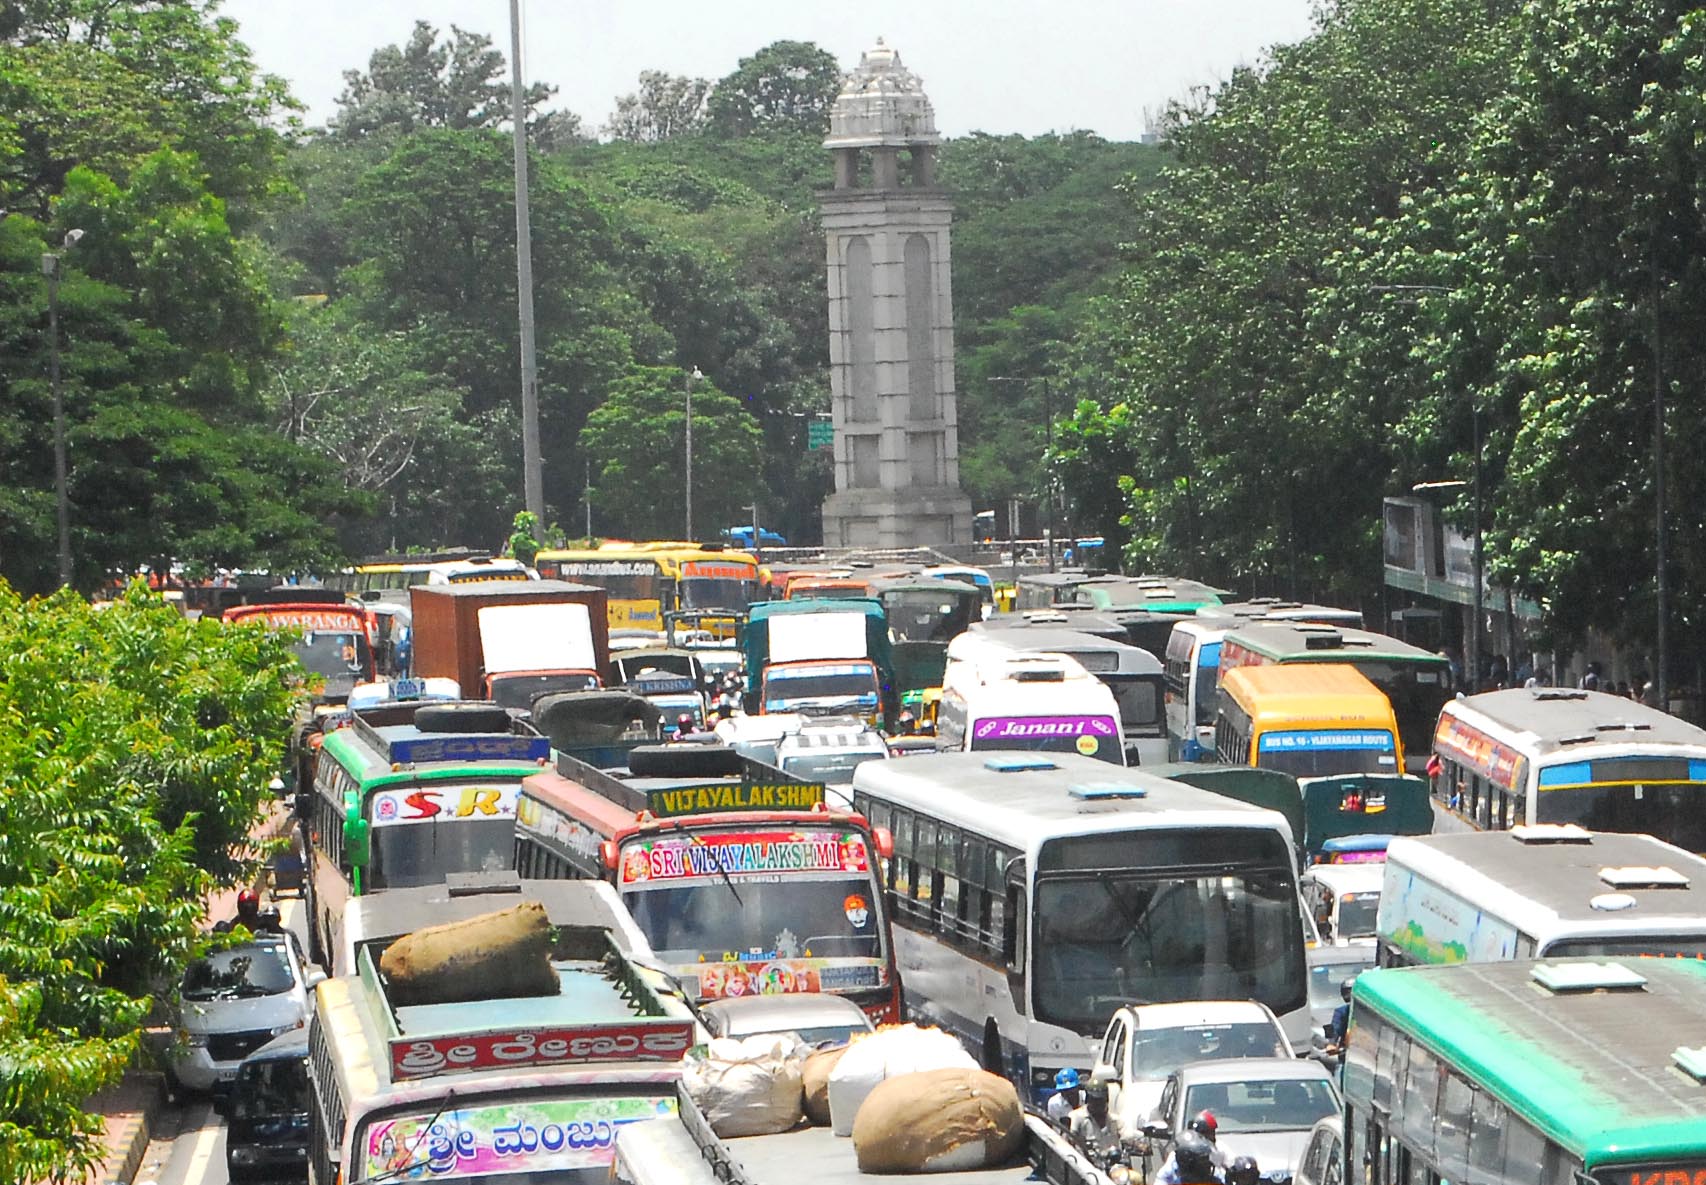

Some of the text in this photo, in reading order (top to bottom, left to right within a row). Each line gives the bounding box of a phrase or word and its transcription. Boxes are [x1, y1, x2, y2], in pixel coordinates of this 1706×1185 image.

[1000, 721, 1085, 735] Janani
[1311, 735, 1362, 745] VIJAYANAGAR
[1363, 734, 1388, 744] ROUTE
[662, 785, 822, 812] VIJAYALAKSHMI
[650, 840, 840, 877] SRI VIJAYALAKSHMI
